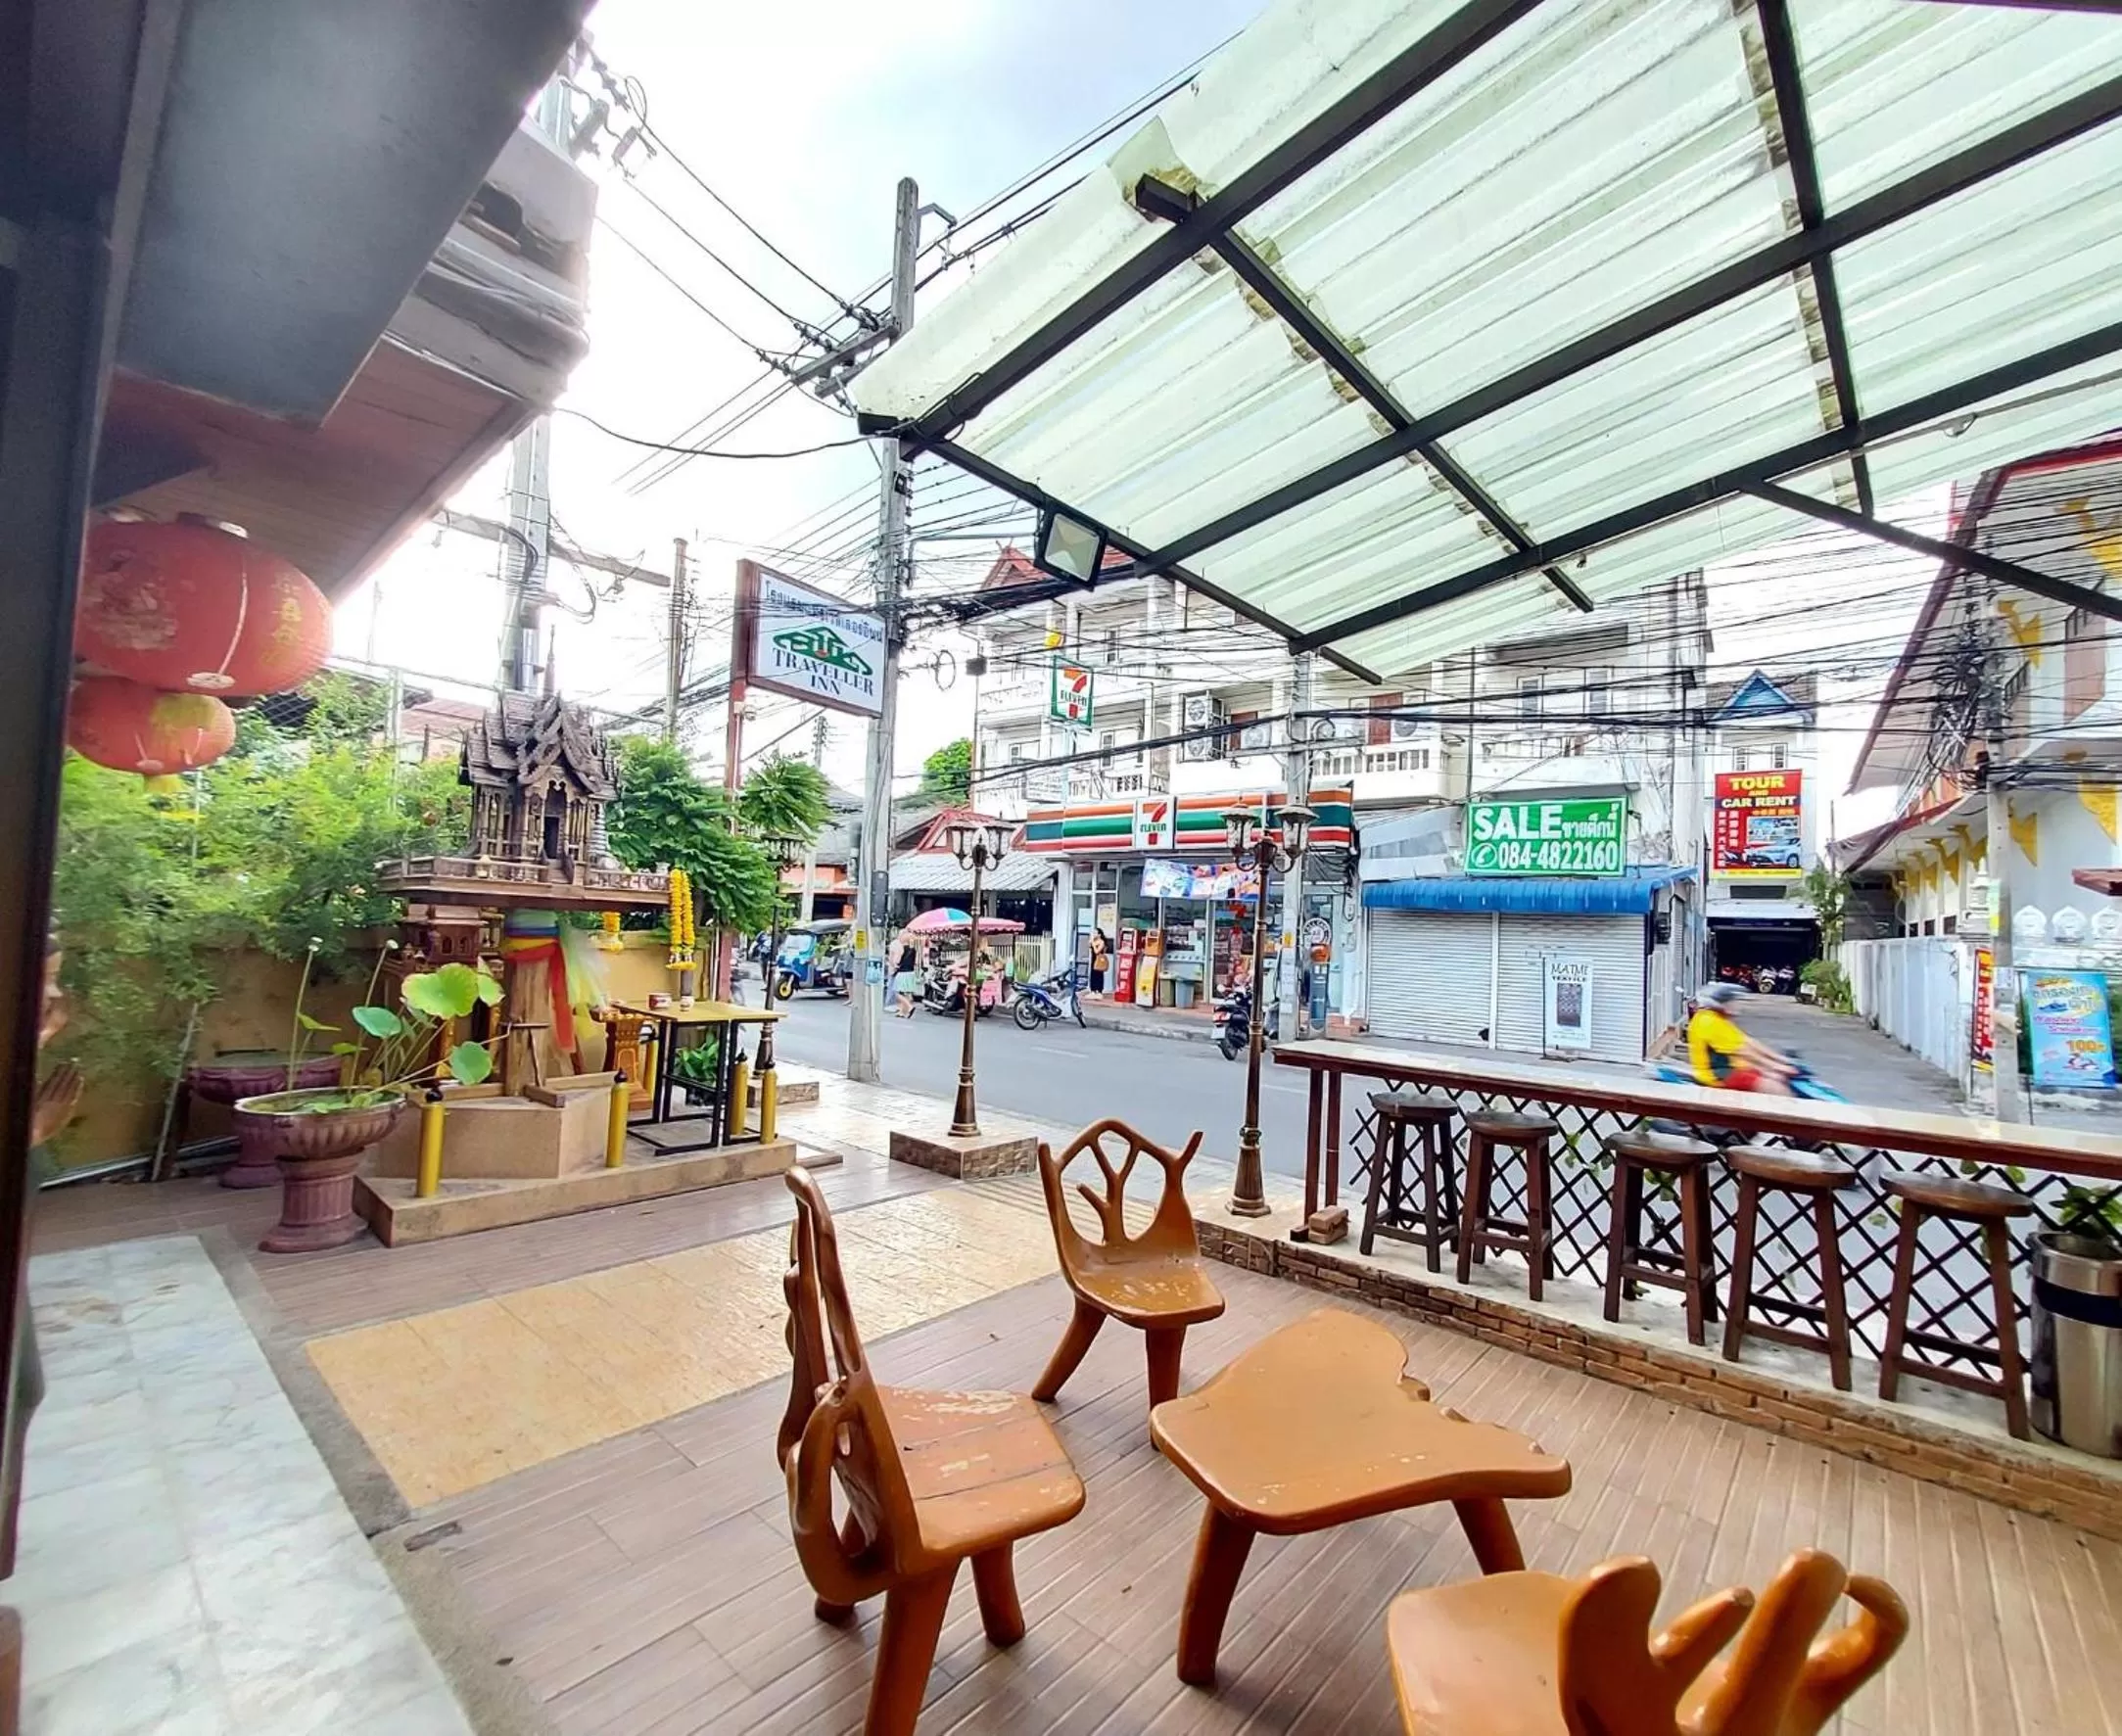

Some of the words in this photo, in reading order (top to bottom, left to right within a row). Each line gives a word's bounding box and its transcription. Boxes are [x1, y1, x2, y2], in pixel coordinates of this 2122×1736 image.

[773, 647, 873, 696] TRAVELLER
[812, 675, 840, 695] INN
[1729, 775, 1785, 791] TOUR
[1721, 797, 1753, 809] CAR
[1755, 795, 1796, 808] RENT
[1474, 805, 1563, 840] SALE
[1499, 840, 1618, 870] 084-4822160
